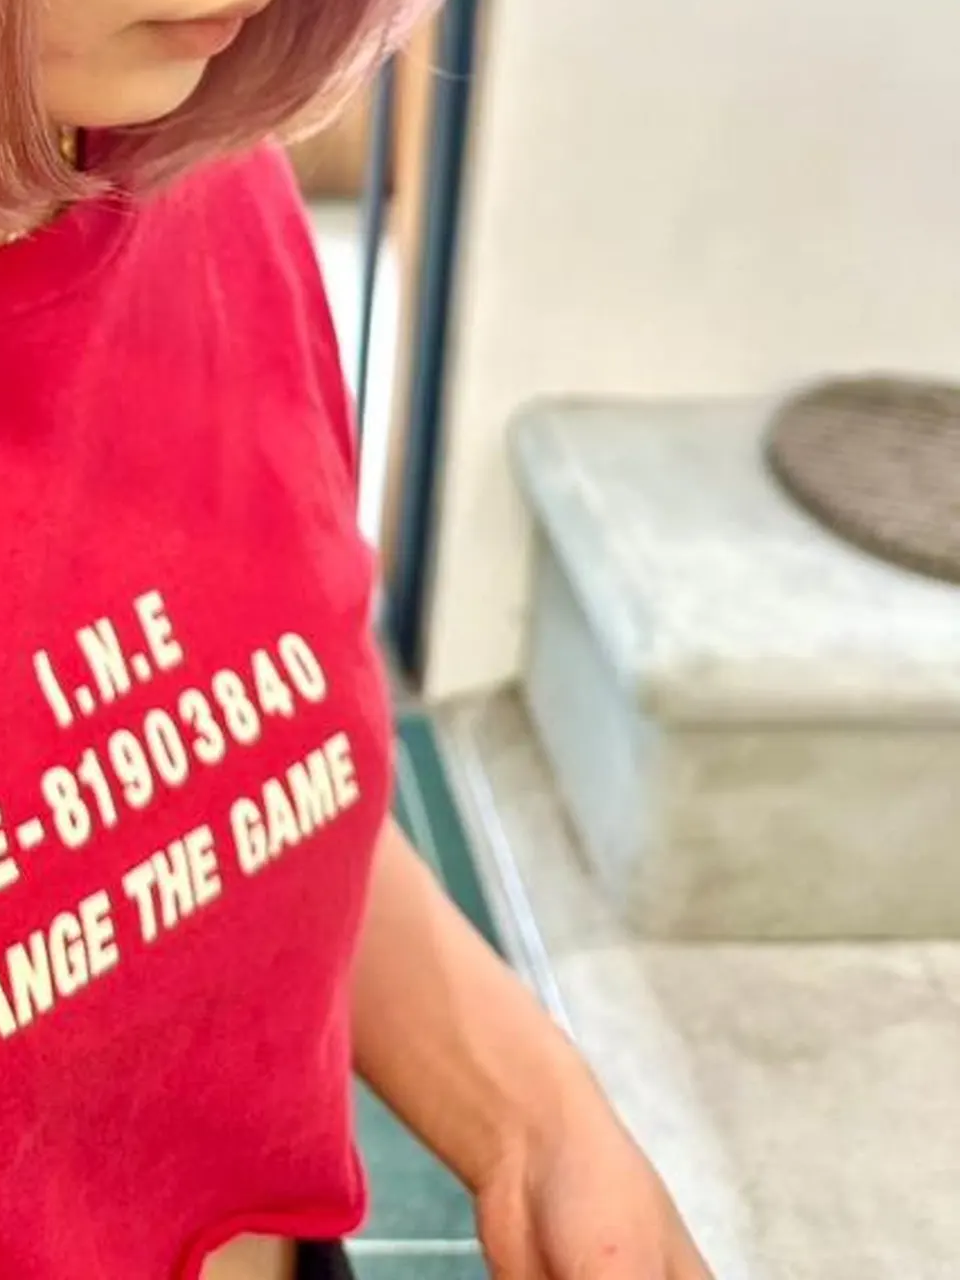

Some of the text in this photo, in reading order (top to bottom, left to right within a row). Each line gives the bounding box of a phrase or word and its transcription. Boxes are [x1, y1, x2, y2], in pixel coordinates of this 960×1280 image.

[34, 590, 183, 727] I.N.E
[122, 824, 222, 942] THE
[230, 732, 360, 875] GAME
